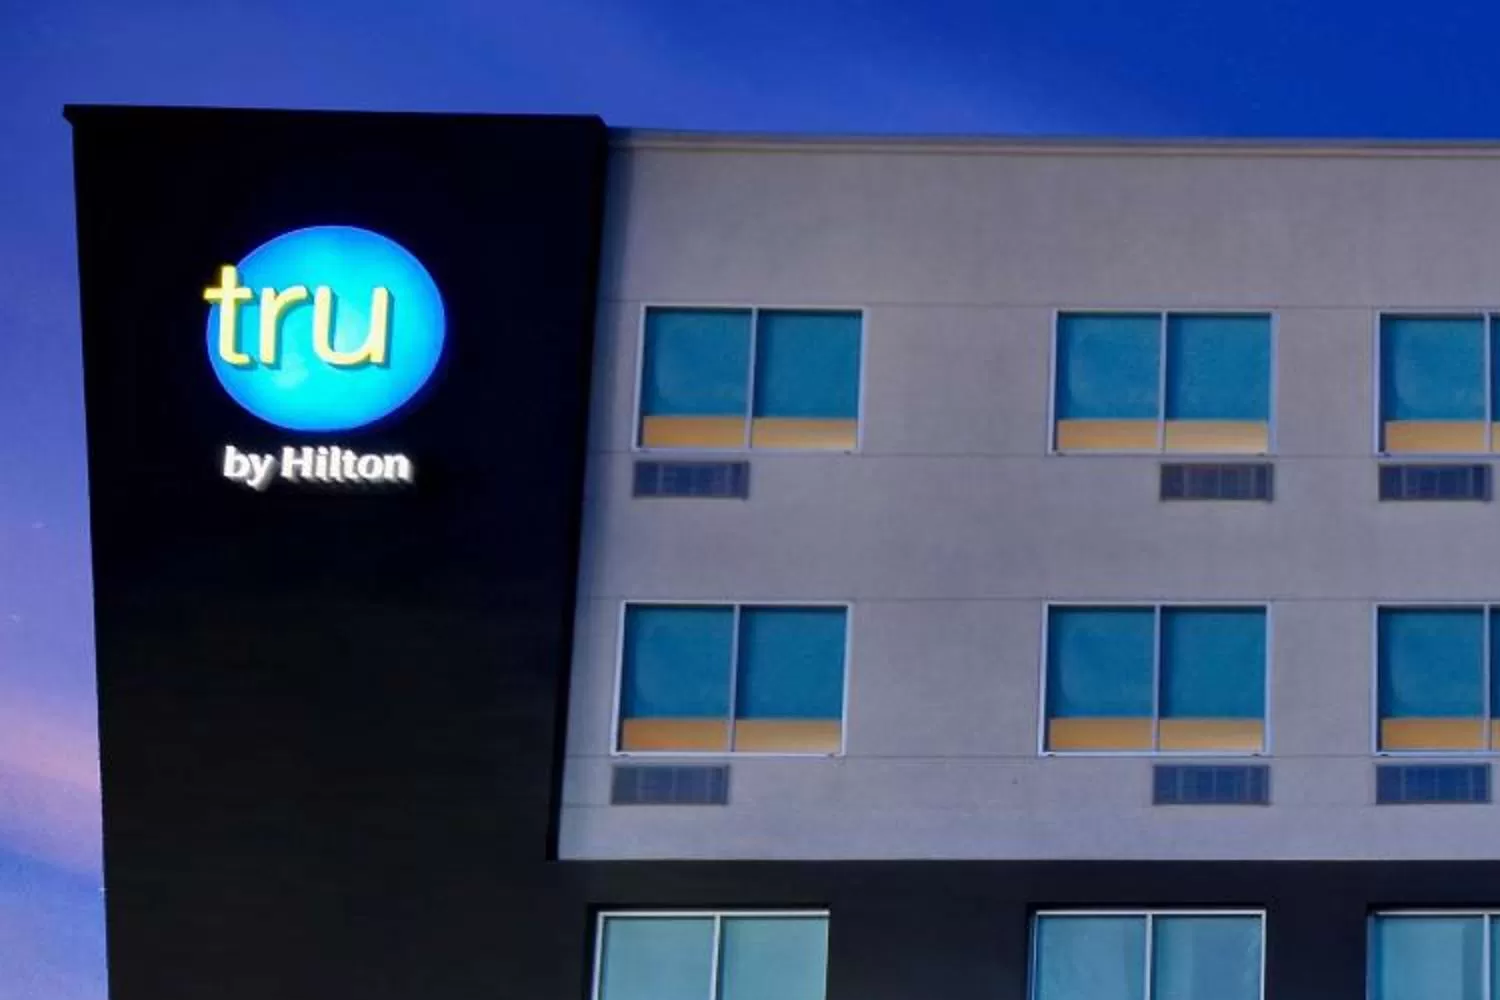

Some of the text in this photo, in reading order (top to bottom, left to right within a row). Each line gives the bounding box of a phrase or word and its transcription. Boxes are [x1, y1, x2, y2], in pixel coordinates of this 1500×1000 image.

[203, 264, 389, 365] tru
[223, 445, 411, 488] by Hilton
